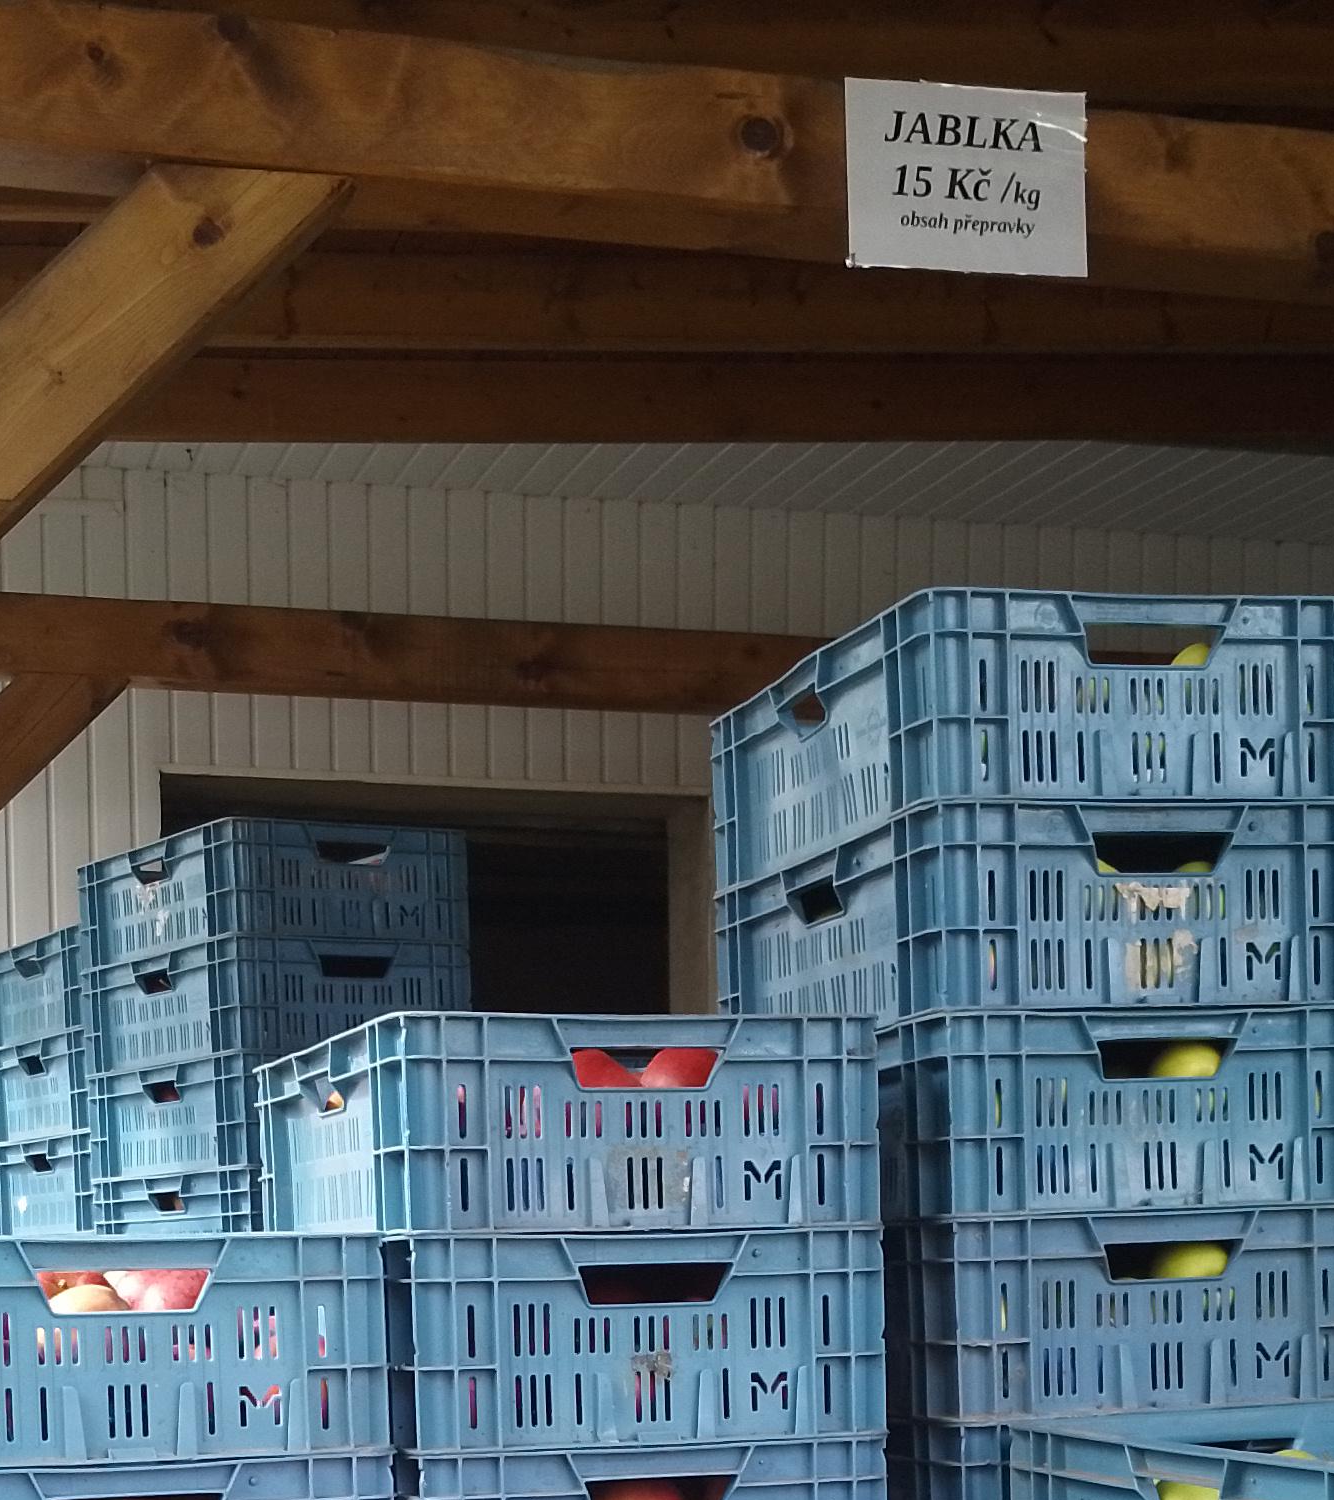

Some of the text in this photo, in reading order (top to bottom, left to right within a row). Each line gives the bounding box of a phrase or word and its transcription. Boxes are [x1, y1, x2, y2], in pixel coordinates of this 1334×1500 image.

[884, 110, 1043, 152] JABLKA
[892, 164, 1041, 211] 15 Kč /kg
[900, 210, 1035, 239] obsah přepravky
